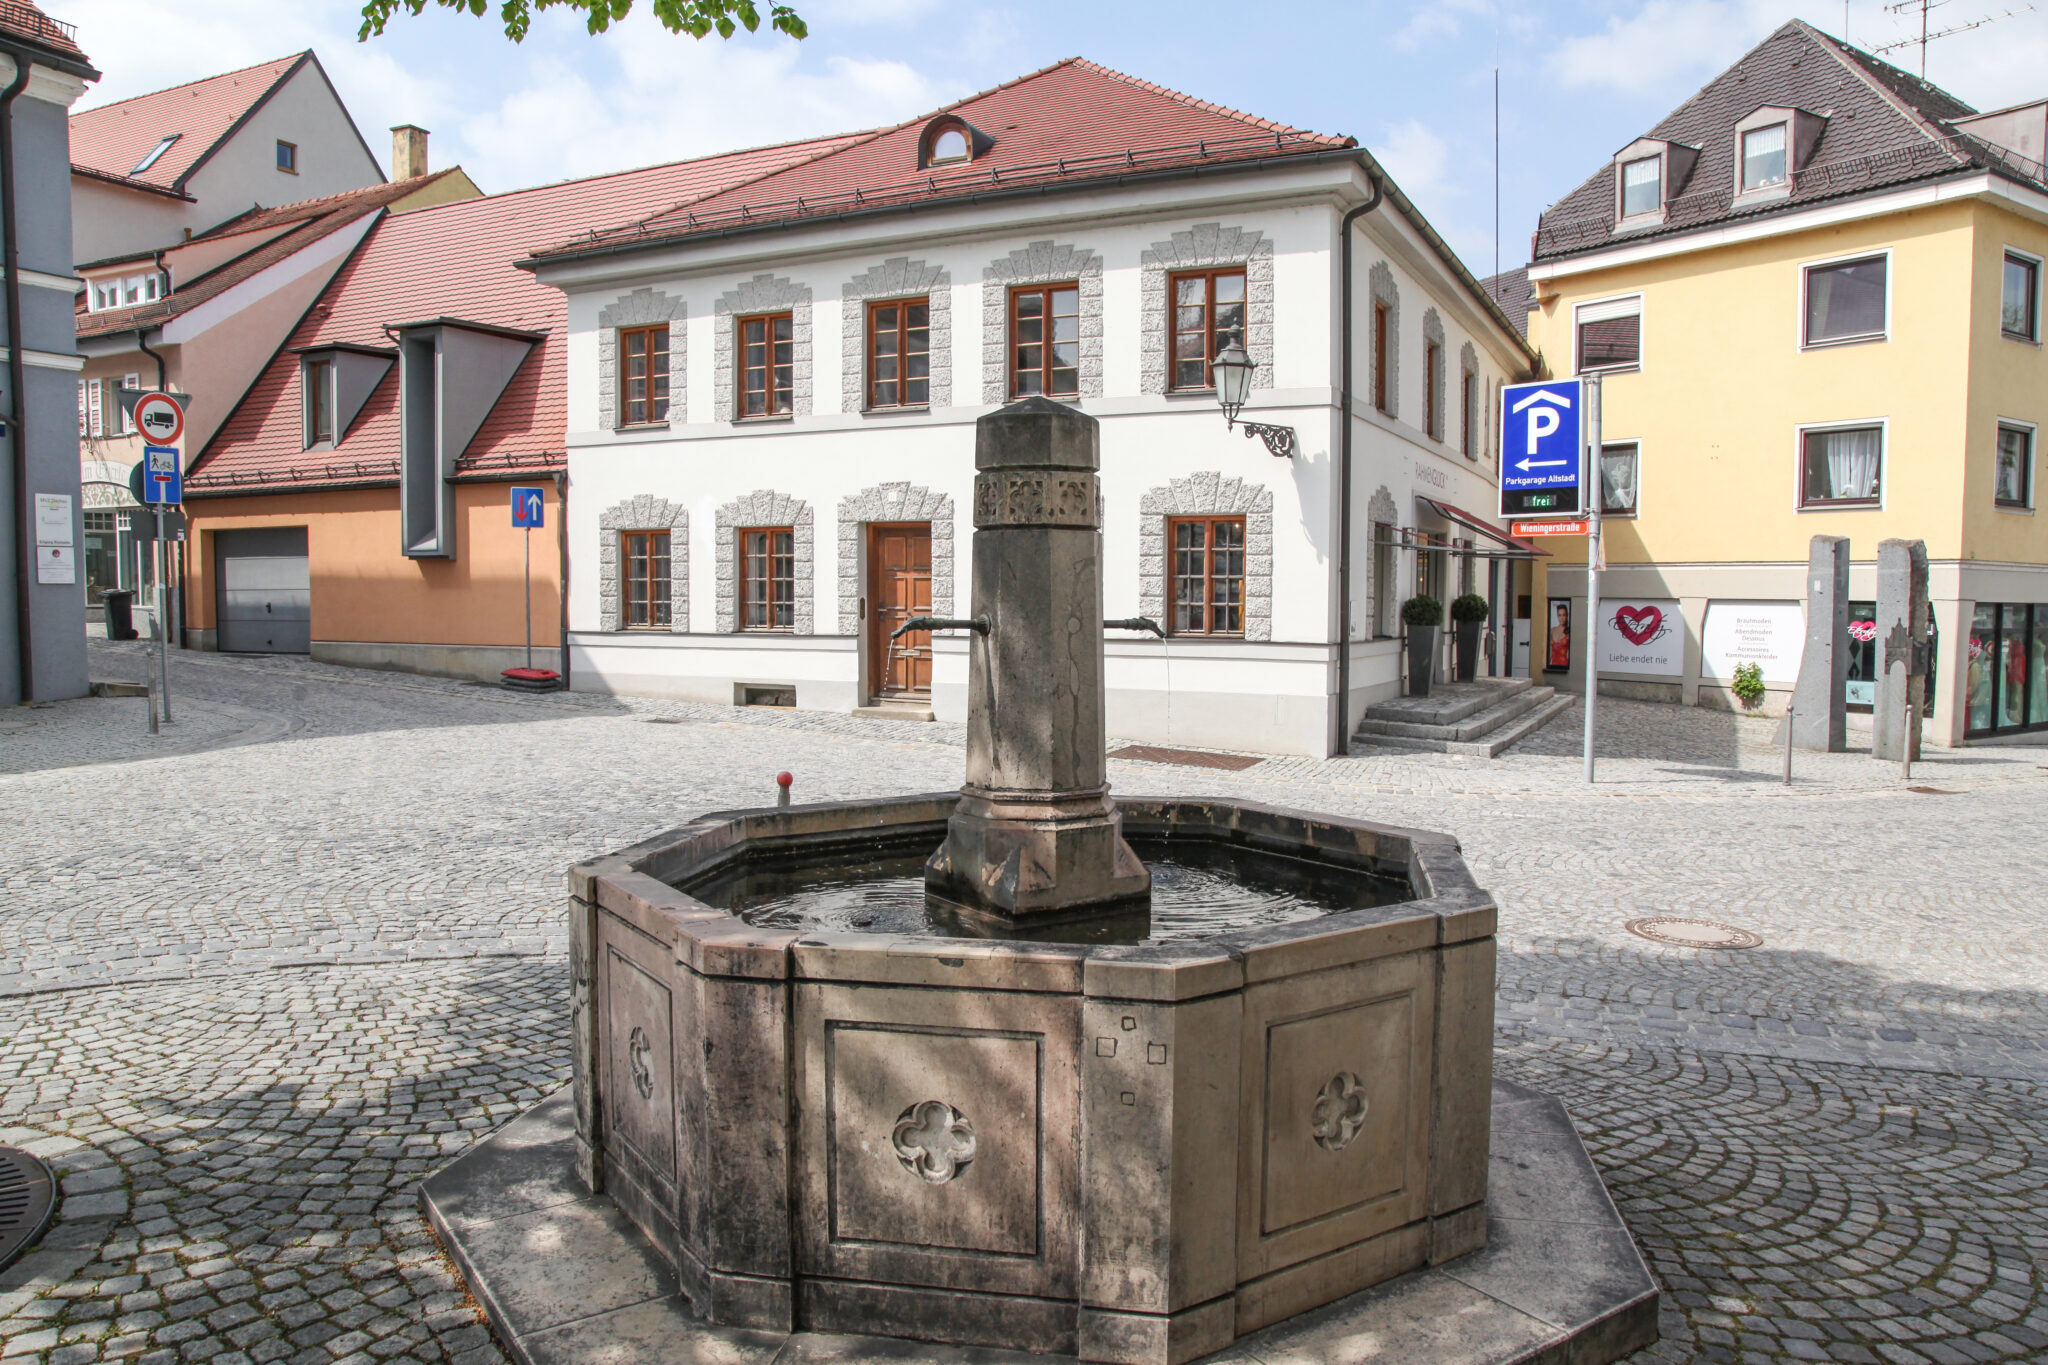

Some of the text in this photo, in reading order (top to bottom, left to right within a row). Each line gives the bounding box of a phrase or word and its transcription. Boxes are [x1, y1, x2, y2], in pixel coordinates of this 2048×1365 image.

[1527, 406, 1560, 455] P
[1505, 473, 1576, 486] Parkgarage Altstadt
[1532, 495, 1550, 506] frei
[1520, 522, 1580, 535] Wieningerstraße
[1736, 617, 1772, 625] Brautmoden
[1735, 628, 1773, 636] Abendmoden
[1609, 653, 1668, 665] Liebe endet nie
[1725, 652, 1778, 660] Kommunionkleider
